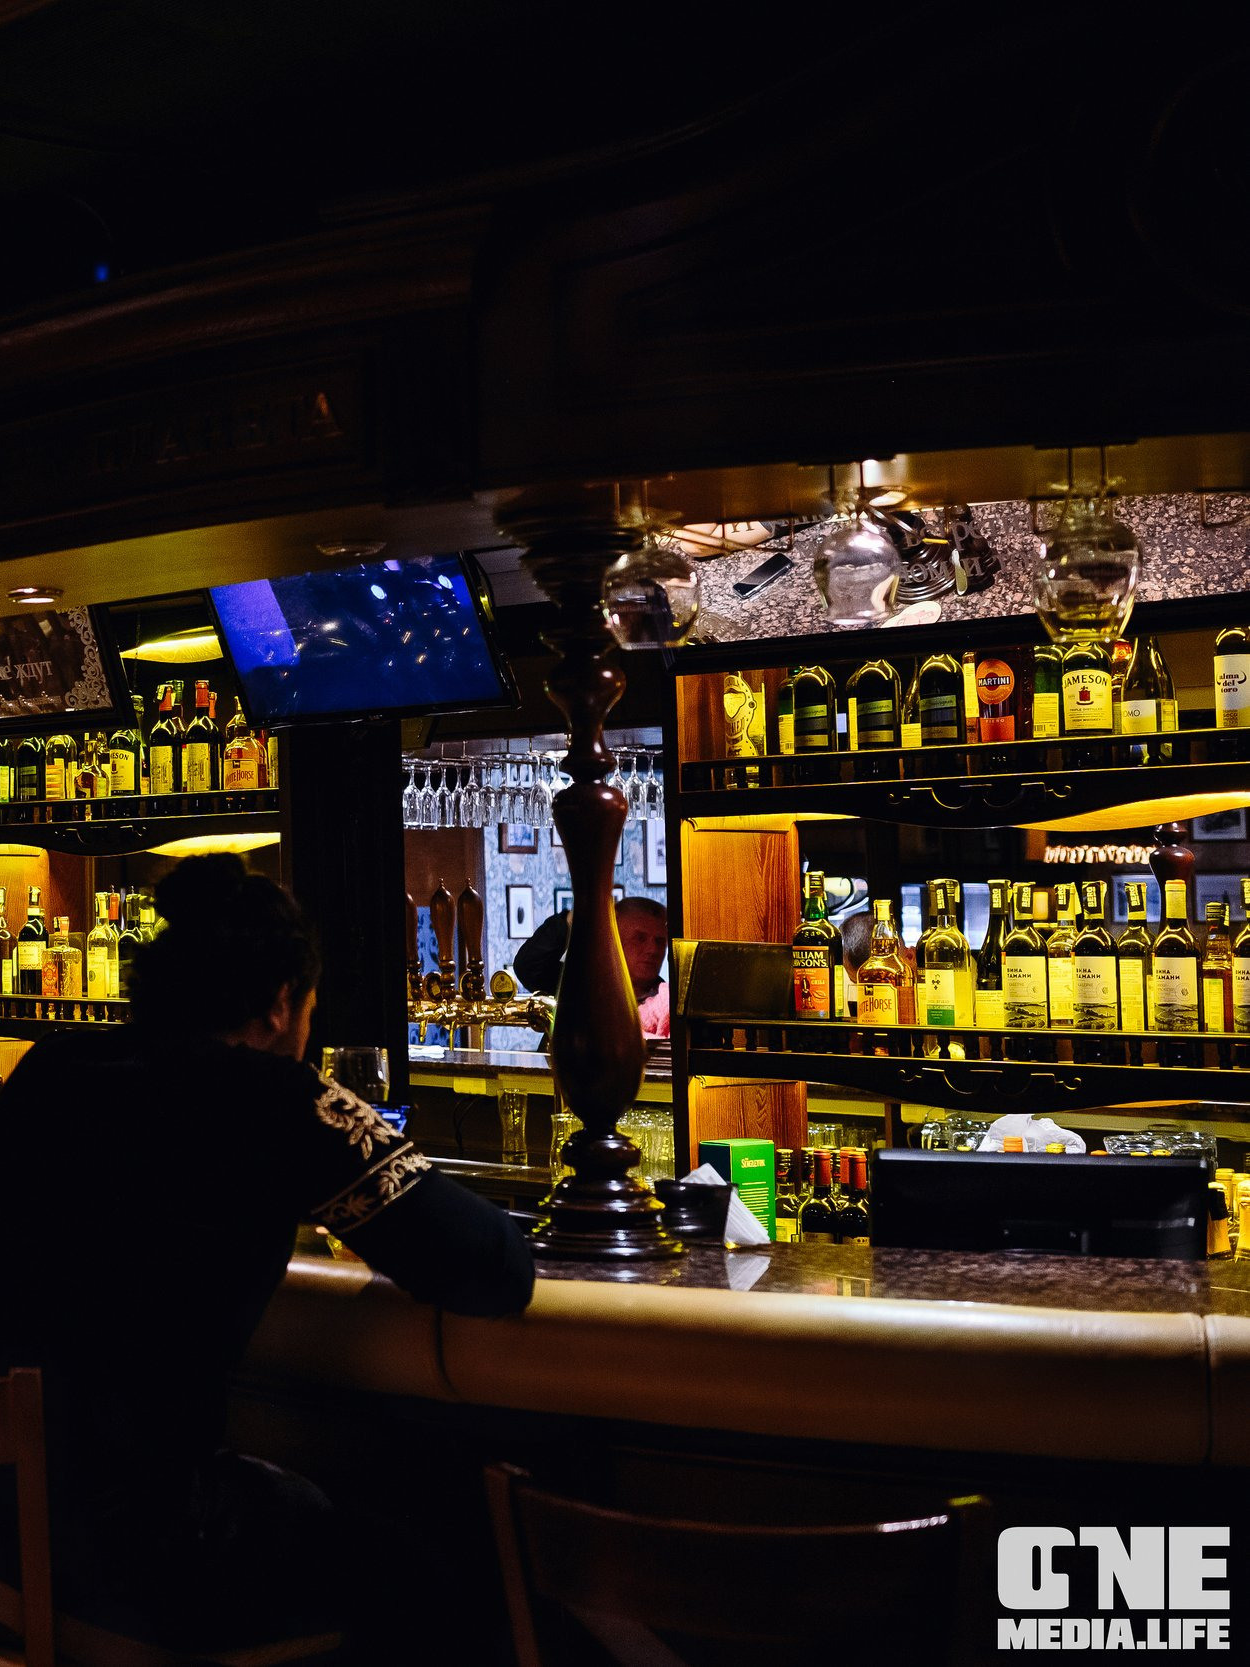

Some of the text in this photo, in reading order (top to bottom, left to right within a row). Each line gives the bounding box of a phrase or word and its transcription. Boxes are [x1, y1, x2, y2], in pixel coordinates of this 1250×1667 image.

[13, 661, 54, 687] ждут
[978, 676, 1010, 686] MARTINI
[1063, 674, 1108, 689] JAMESON
[869, 996, 892, 1013] HORSE
